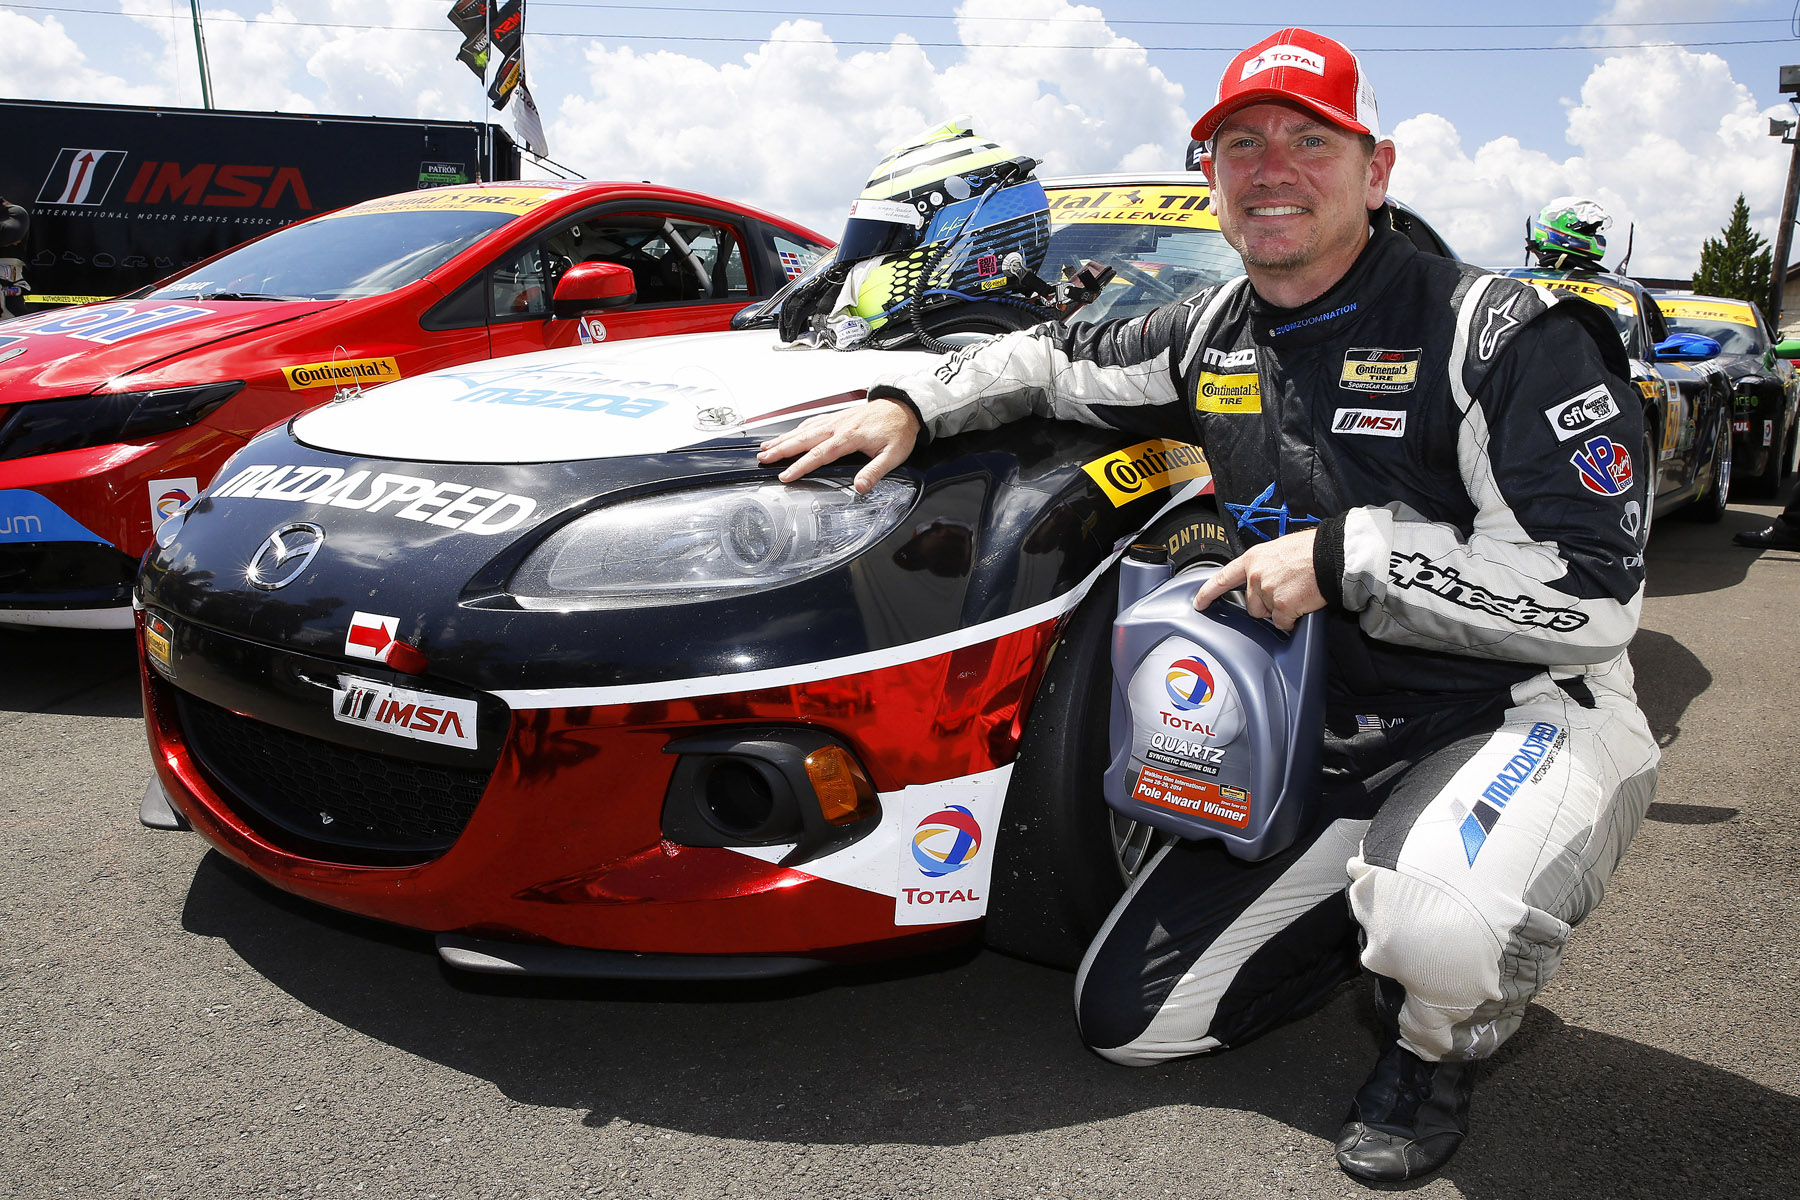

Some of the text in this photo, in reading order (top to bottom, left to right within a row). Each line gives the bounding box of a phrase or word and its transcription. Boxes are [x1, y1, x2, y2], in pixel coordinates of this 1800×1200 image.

[1270, 53, 1321, 69] TOTAL
[123, 161, 314, 211] IMSA
[461, 195, 516, 205] TIRE
[31, 208, 129, 220] INTERNATIONAL
[137, 213, 176, 222] MOTOR
[183, 215, 228, 223] SPORTS
[1055, 210, 1194, 222] CHALLENGE
[1544, 282, 1596, 295] TIRE
[72, 296, 88, 304] ACCESS
[1203, 347, 1256, 368] mazd
[291, 361, 380, 386] Continental
[1356, 364, 1402, 376] Continental
[1202, 382, 1252, 398] Continental
[1219, 397, 1243, 405] TIRE
[1357, 415, 1402, 431] IMSA
[1563, 406, 1586, 427] sfi
[1571, 436, 1615, 494] VP
[208, 464, 538, 536] MAZDASPEED
[1163, 523, 1229, 556] ONTINE
[375, 699, 465, 738] IMSA
[1160, 711, 1216, 737] TOTAL
[1150, 732, 1226, 764] QUARTZ
[1148, 751, 1217, 775] SYNTHETIC ENGINE OILS
[1482, 722, 1559, 809] MAZDASPEED
[1141, 776, 1154, 784] June
[1144, 769, 1207, 791] Watkins Glen International
[1137, 783, 1161, 799] Pole
[1163, 791, 1202, 810] Award
[1203, 800, 1247, 822] Winner
[902, 887, 980, 905] TOTAL
